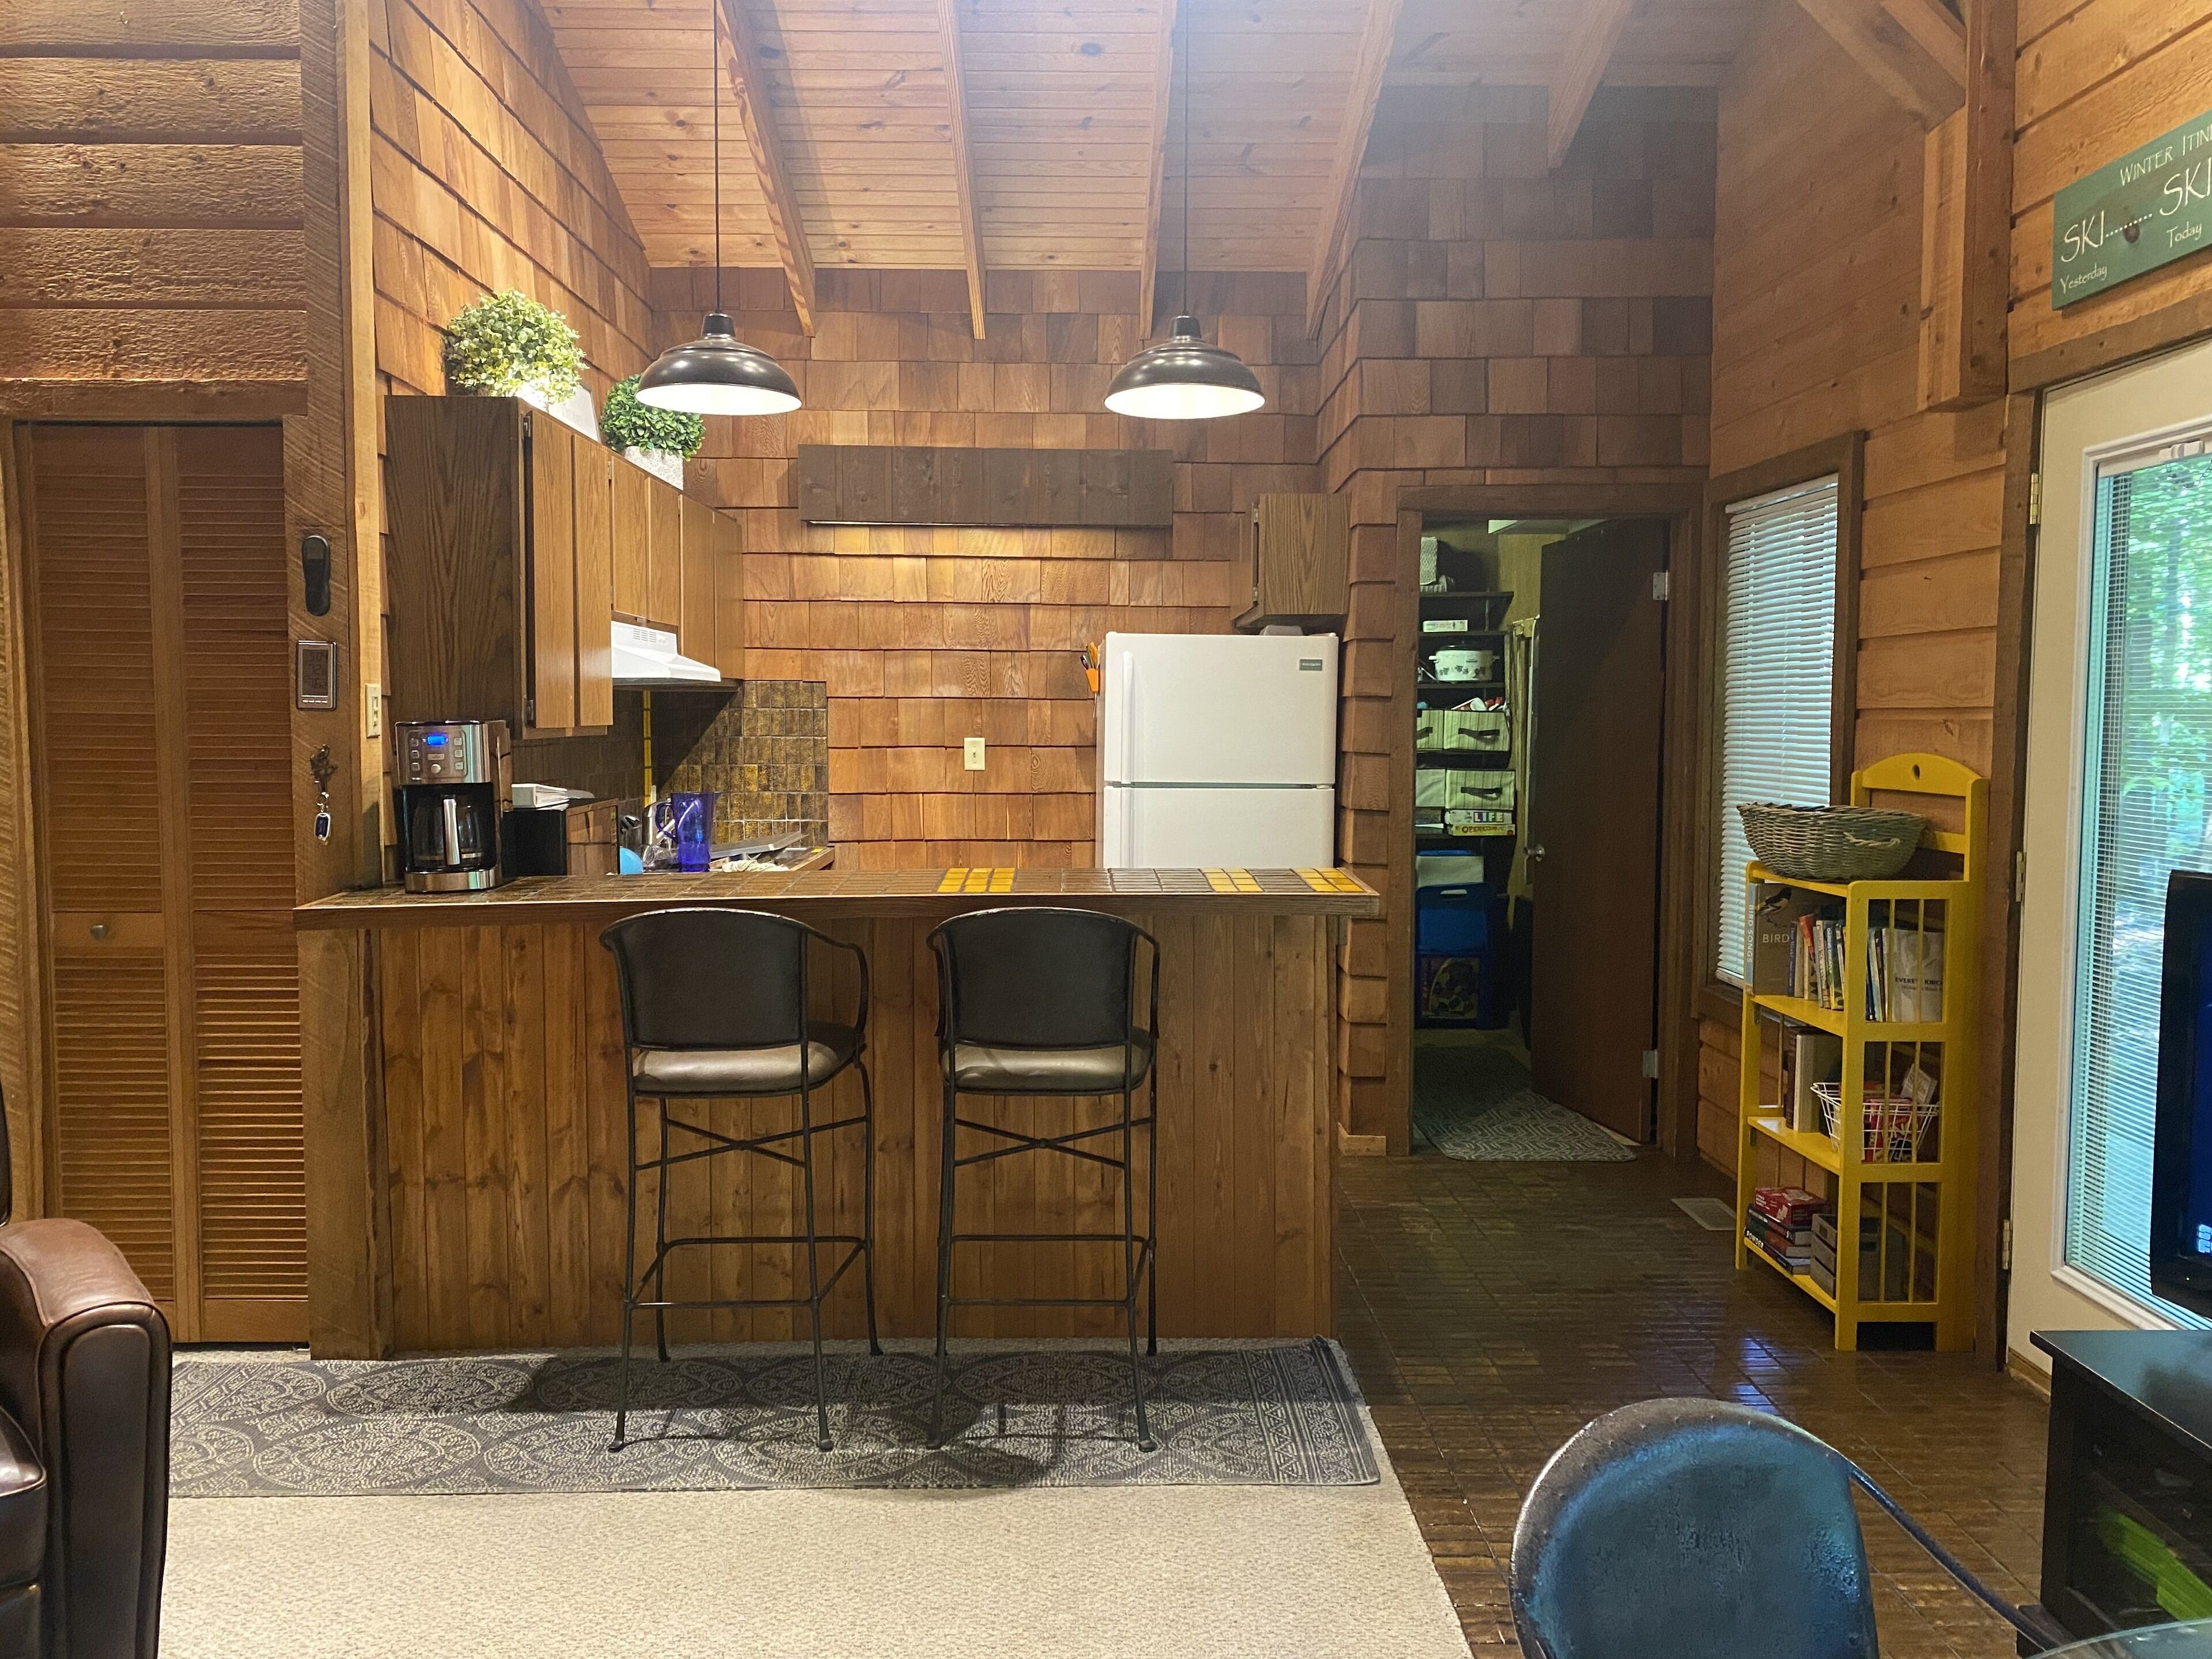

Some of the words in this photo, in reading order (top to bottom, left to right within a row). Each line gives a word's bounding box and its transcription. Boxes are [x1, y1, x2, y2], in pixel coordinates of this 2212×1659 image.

[2120, 146, 2173, 187] WINTER
[2061, 210, 2104, 263] SKI
[2160, 157, 2212, 215] SKI
[2060, 262, 2107, 294] Yesterday
[2166, 221, 2202, 248] Today
[1474, 812, 1503, 822] LIFE
[1762, 934, 1790, 943] BIRD
[1746, 1230, 1764, 1249] POWDER
